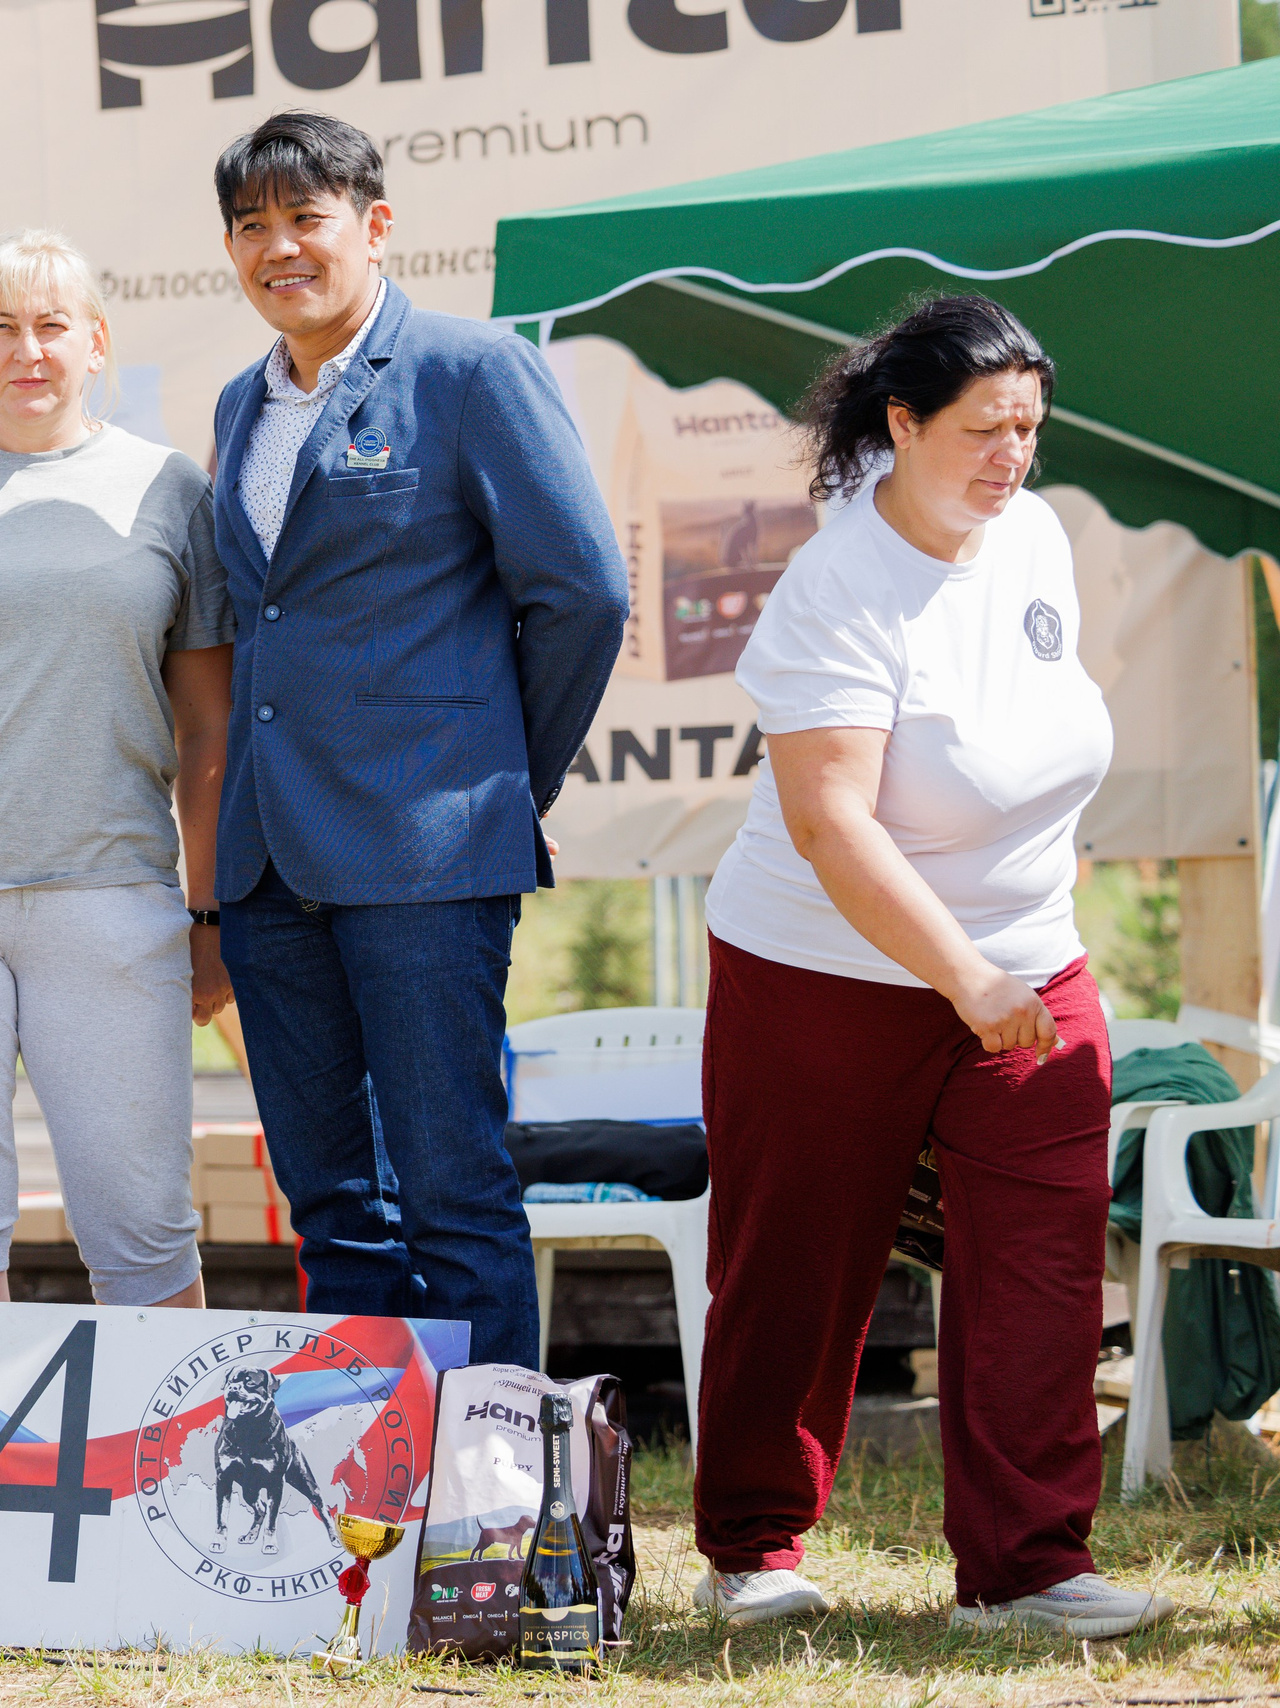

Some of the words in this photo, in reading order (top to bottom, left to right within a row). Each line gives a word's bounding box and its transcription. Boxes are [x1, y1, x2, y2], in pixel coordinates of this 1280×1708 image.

[381, 108, 649, 168] remium
[139, 1334, 254, 1522] РОТВЕЙЛЕР
[275, 1330, 368, 1378] КЛУБ
[464, 1400, 541, 1433] Han
[496, 1424, 542, 1442] premium
[552, 1433, 561, 1488] SEMI-SWEET
[194, 1559, 345, 1598] РКФ-НКПР
[524, 1631, 533, 1641] DI
[536, 1630, 590, 1641] CASPICO
